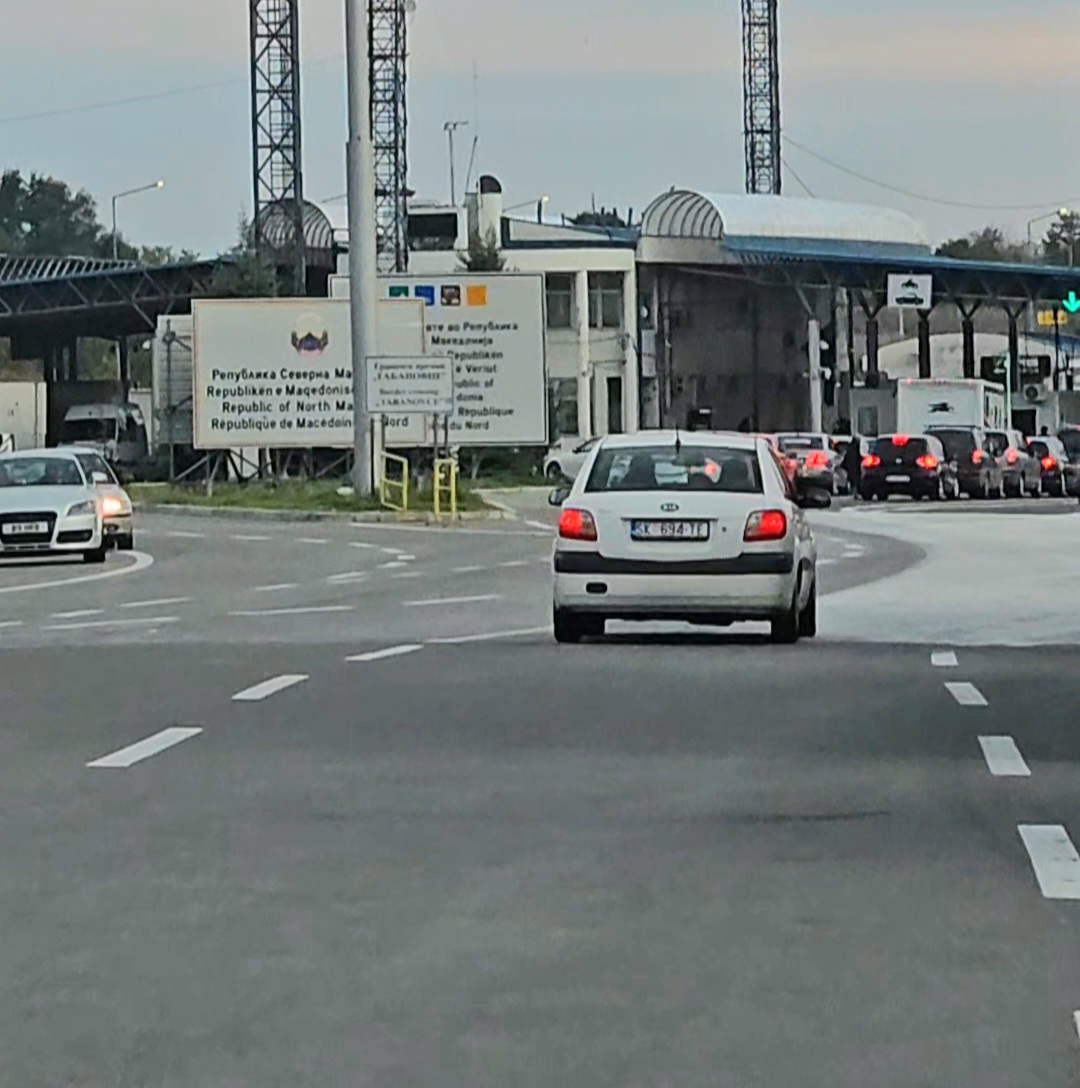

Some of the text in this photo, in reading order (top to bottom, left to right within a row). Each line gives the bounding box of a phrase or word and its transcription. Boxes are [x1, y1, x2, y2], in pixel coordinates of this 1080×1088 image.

[463, 320, 519, 333] Република
[431, 335, 493, 347] Македонија
[465, 363, 497, 374] Veriut
[212, 368, 276, 382] Република
[280, 368, 330, 381] Северна
[484, 378, 494, 388] of
[222, 401, 273, 415] Republic
[279, 401, 290, 413] of
[296, 401, 330, 412] North
[280, 417, 293, 429] de
[465, 420, 490, 431] Nord
